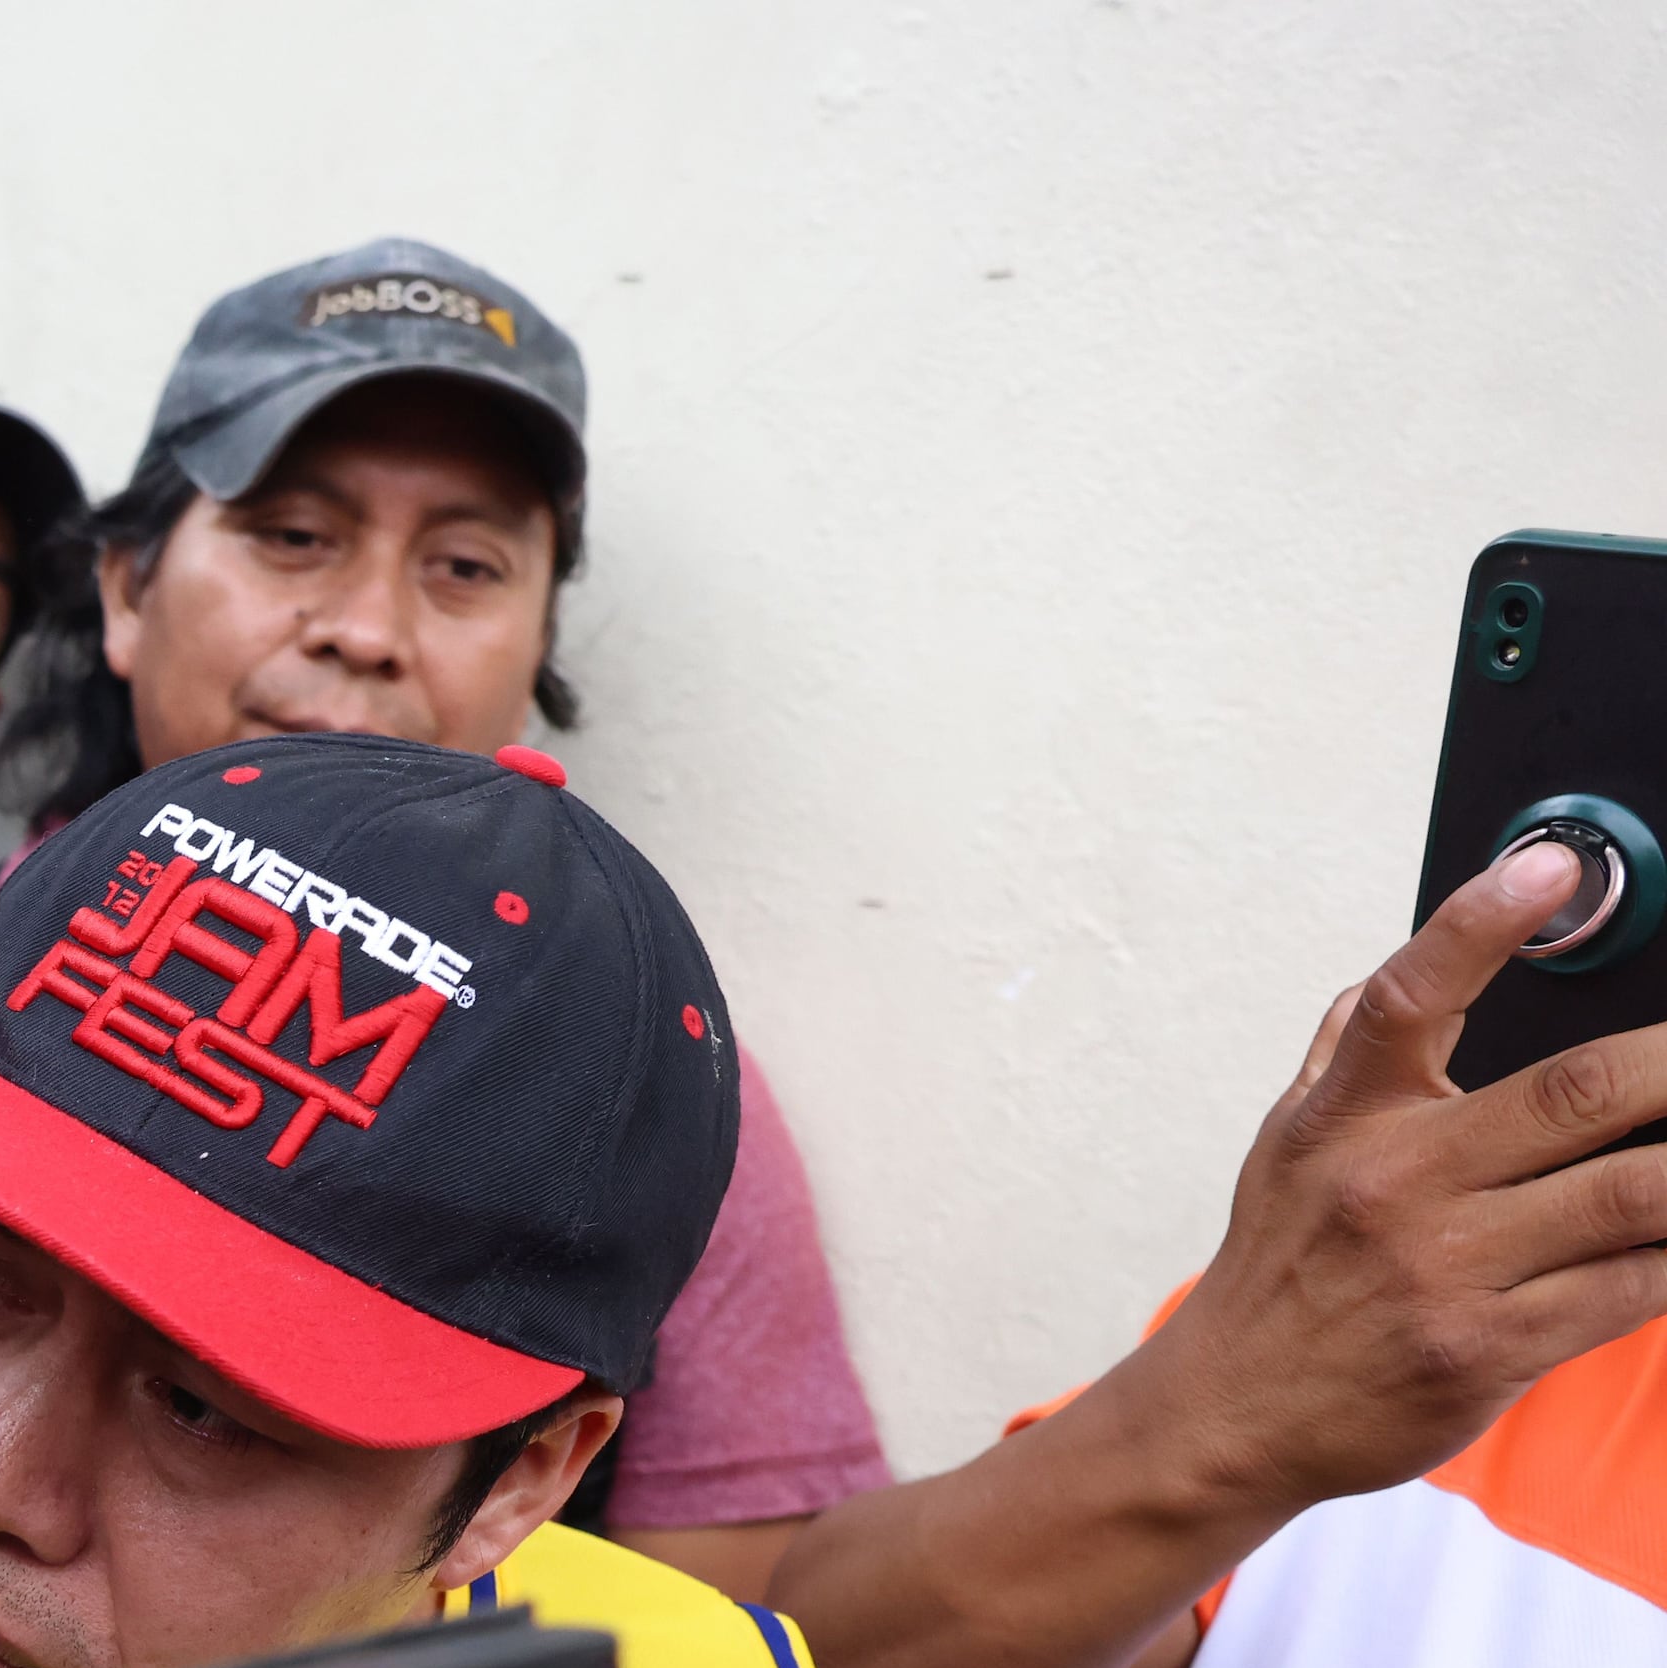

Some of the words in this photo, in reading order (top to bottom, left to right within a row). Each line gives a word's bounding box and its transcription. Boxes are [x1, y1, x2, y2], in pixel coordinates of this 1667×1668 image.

[100, 880, 142, 918] 12
[118, 849, 163, 889] 20
[68, 854, 449, 1107] JAM
[5, 937, 379, 1169] FEST
